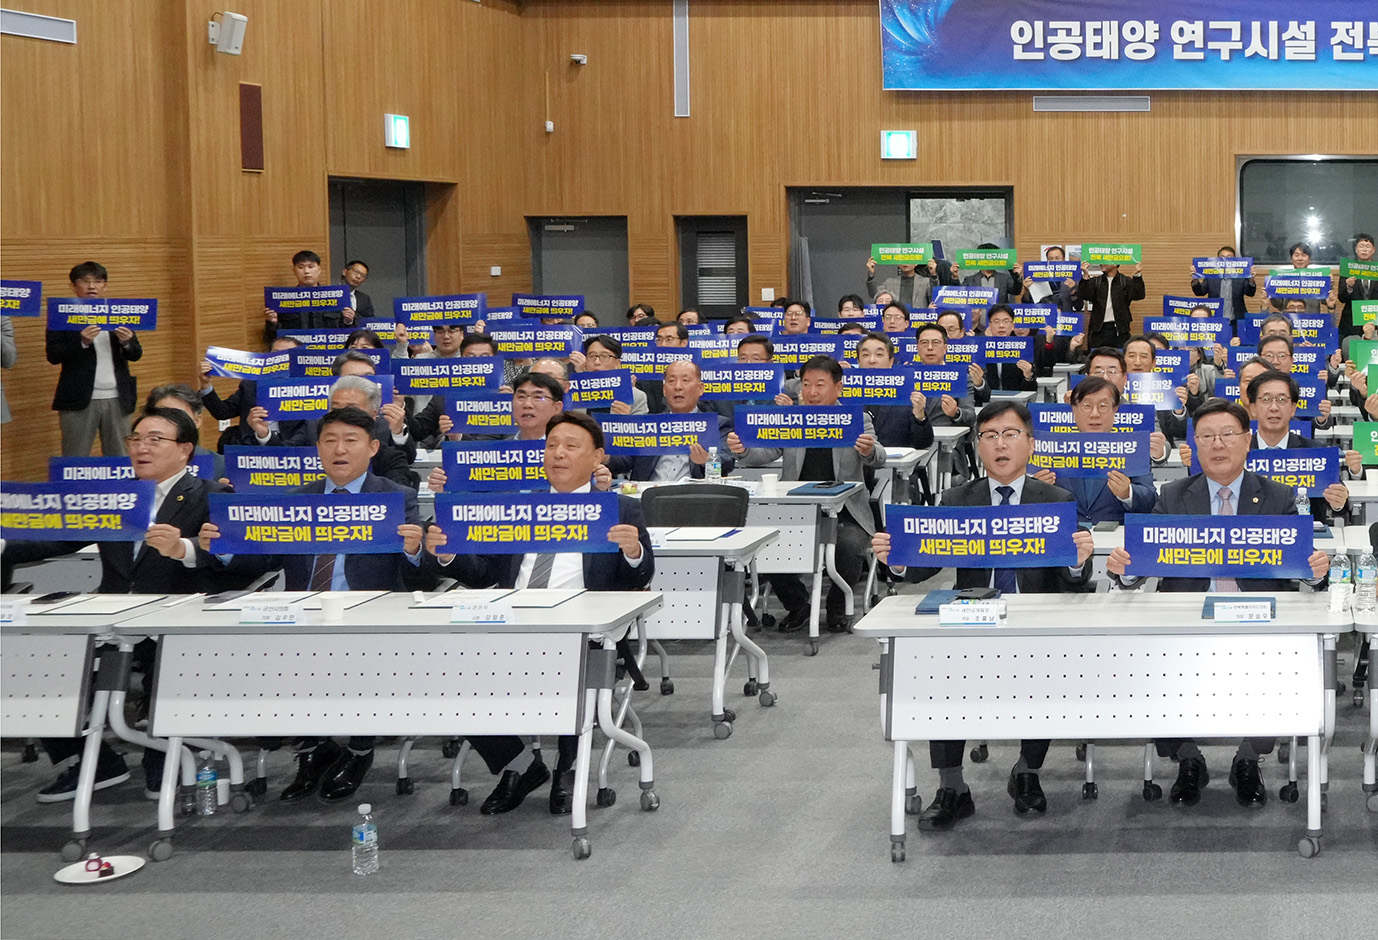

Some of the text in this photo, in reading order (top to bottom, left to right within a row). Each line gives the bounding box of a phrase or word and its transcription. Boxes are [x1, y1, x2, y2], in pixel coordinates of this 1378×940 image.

[1011, 21, 1159, 60] 인공태양
[1171, 21, 1315, 60] 연구시설
[311, 289, 344, 299] 인공태양
[58, 304, 150, 315] 미래에너지 인공태양
[401, 299, 479, 312] 미래에너지 인공태양
[67, 315, 141, 325] 새만금에 띄우자!
[410, 309, 473, 321] 새만금에 띄우자!
[1151, 322, 1222, 331] 미래에너지 인공태양
[536, 330, 574, 341] 인공태양
[1190, 332, 1216, 341] 띄우자!
[496, 341, 566, 352] 새만금에 띄우자!
[400, 363, 494, 376] 미래에너지 인공태양
[410, 376, 486, 389] 새만금에 띄우자!
[746, 413, 853, 426] 미래에너지 인공태양
[601, 421, 707, 434] 미래에너지 인공태양
[756, 427, 844, 440] 새만금에 띄우자!
[612, 434, 699, 448] 새만금에 띄우자!
[1084, 442, 1137, 454] 인공태양
[1028, 455, 1126, 469] 새만금에 띄우자!
[64, 494, 137, 510] 인공태양
[228, 505, 387, 521] 미래에너지 인공태양
[453, 505, 601, 521] 미래에너지 인공태양
[65, 515, 122, 529] 띄우자!
[904, 517, 1060, 535] 미래에너지 인공태양
[245, 526, 372, 542] 새만금에 띄우자!
[467, 525, 588, 541] 새만금에 띄우자!
[1144, 528, 1297, 544] 미래에너지 인공태양
[920, 539, 1045, 555] 새만금에 띄우자!
[1158, 549, 1282, 565] 새만금에 띄우자!
